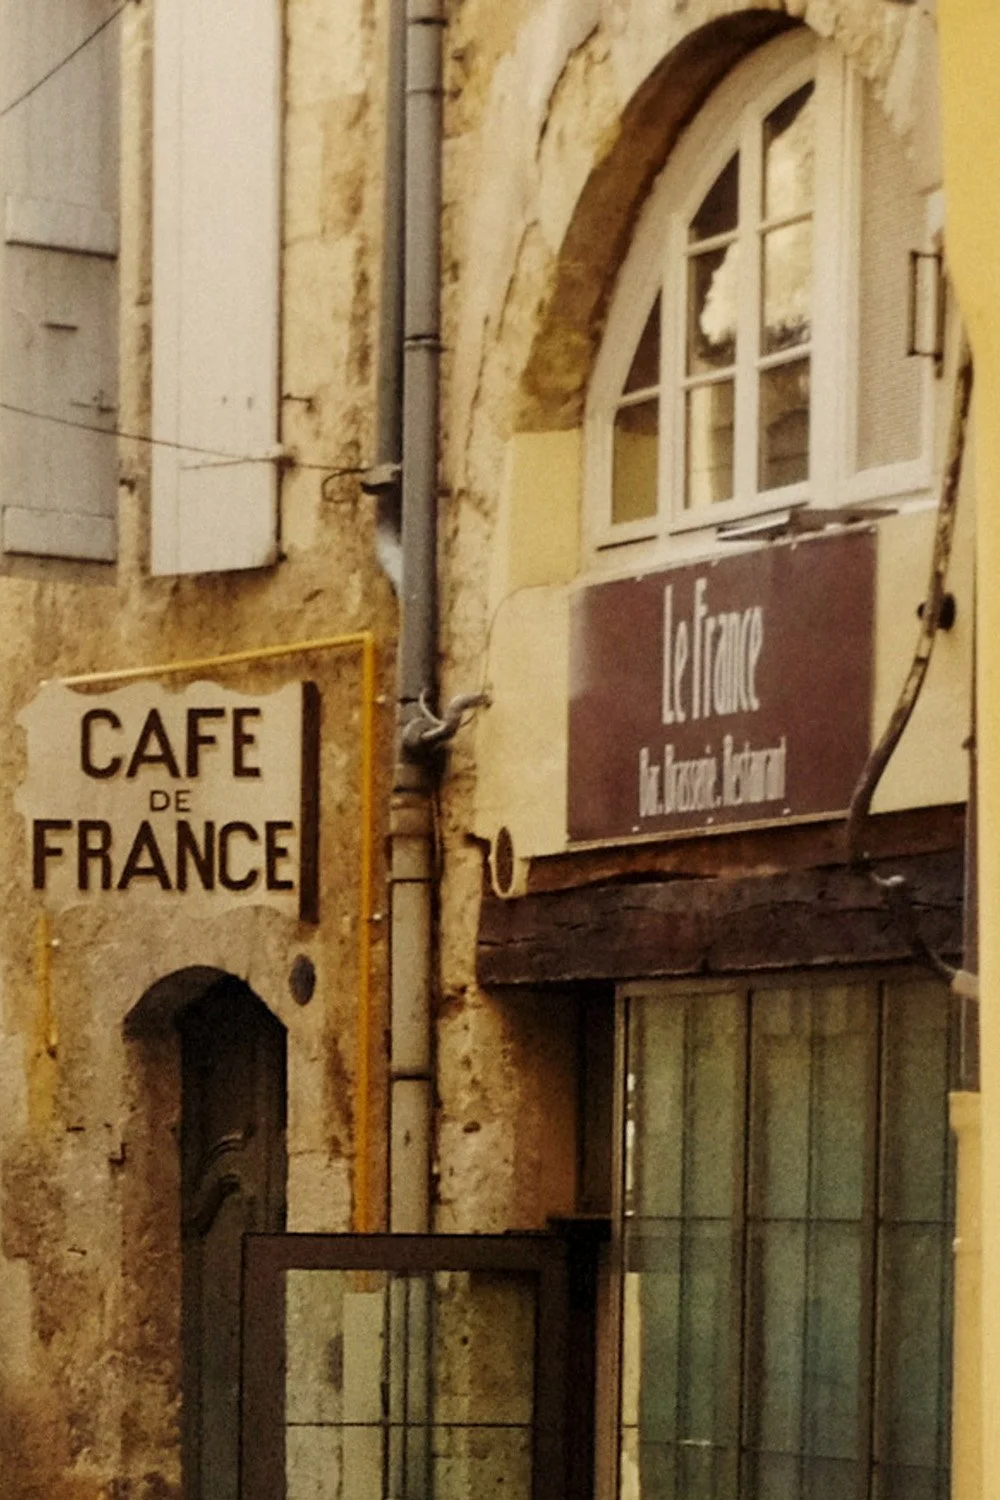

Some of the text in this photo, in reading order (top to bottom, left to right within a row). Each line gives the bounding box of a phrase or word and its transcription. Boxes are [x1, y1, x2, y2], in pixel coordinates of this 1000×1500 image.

[662, 577, 763, 725] Le France
[80, 707, 262, 779] CAFE
[149, 789, 192, 812] DE
[32, 818, 295, 892] FRANCE
